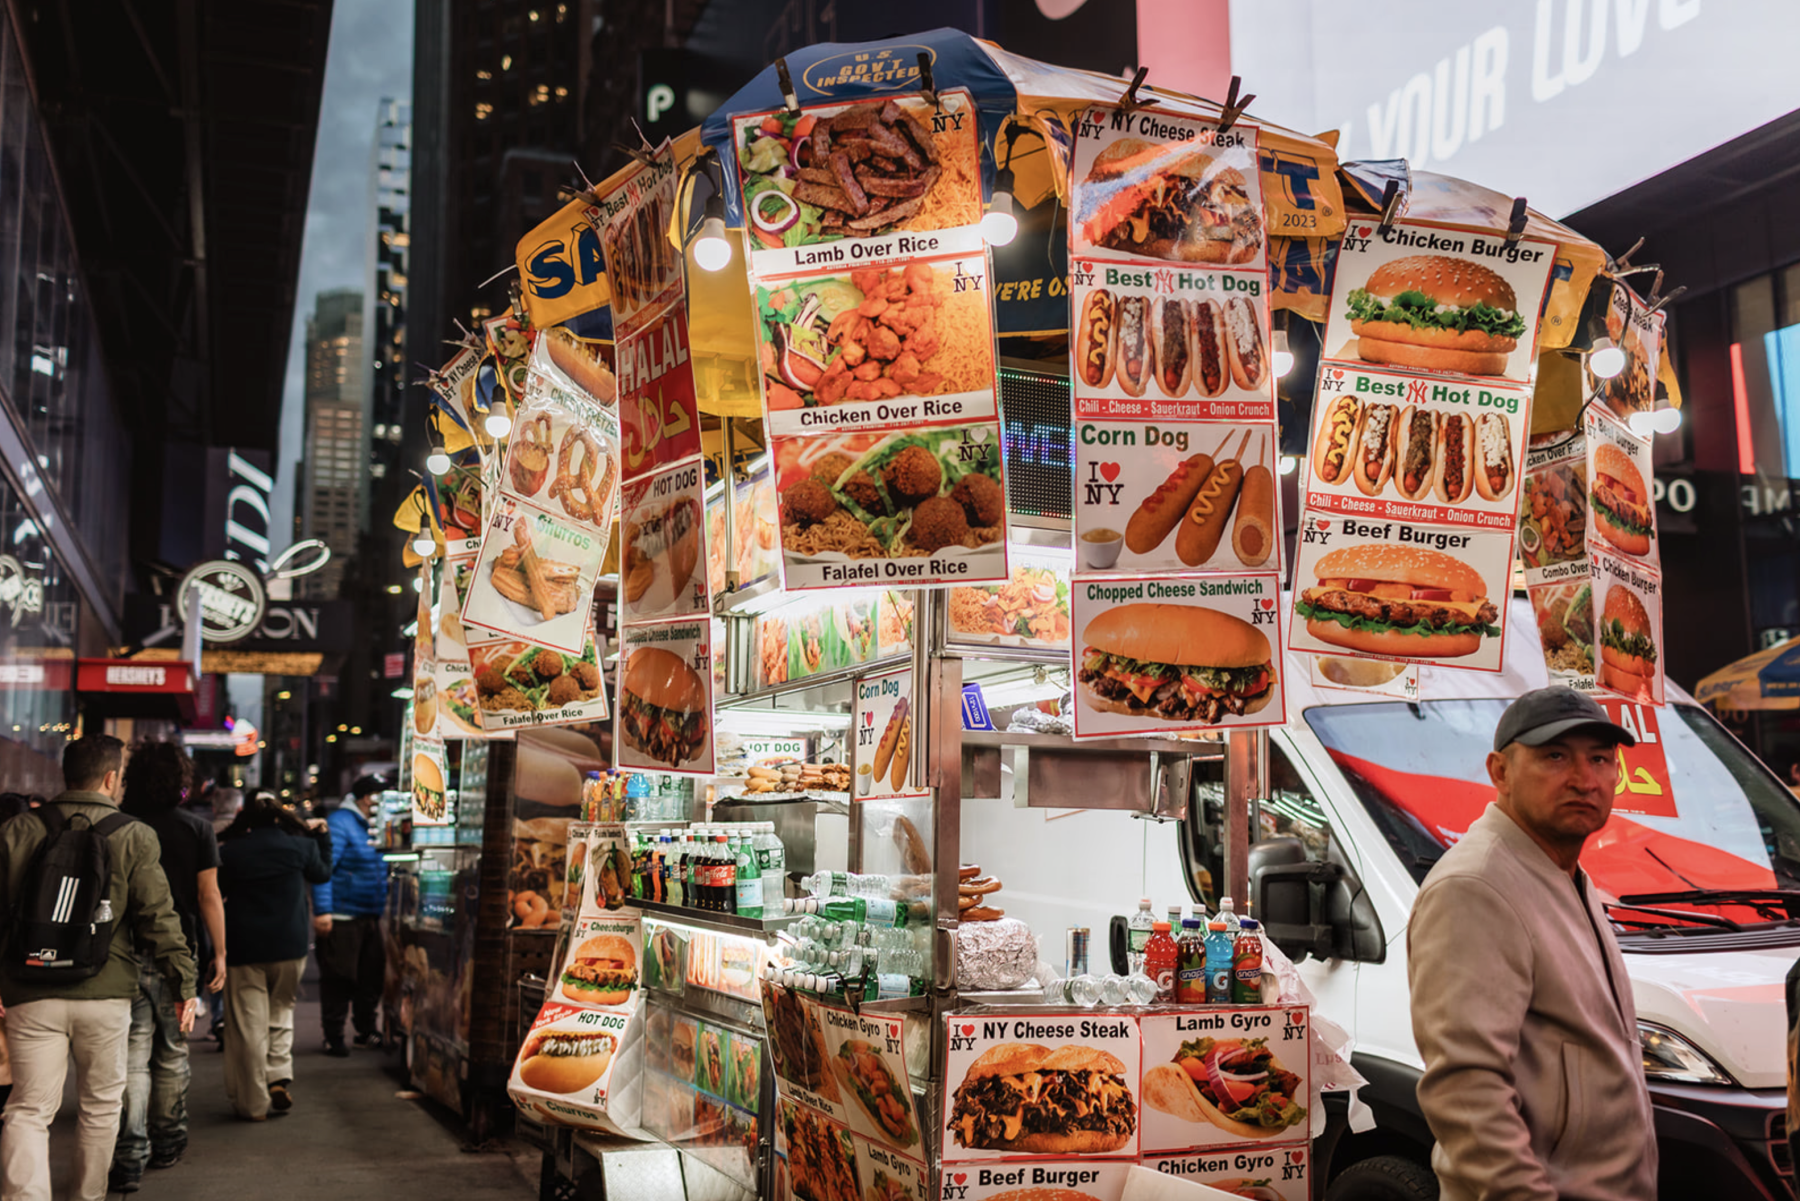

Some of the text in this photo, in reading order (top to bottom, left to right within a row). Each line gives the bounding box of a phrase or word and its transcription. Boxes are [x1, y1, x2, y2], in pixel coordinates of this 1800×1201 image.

[816, 65, 921, 88] INSPECTED
[839, 58, 904, 77] GOV'T
[932, 113, 966, 134] NY
[1083, 109, 1093, 123] I
[1079, 123, 1105, 140] NY
[1110, 114, 1137, 132] NY
[1139, 116, 1196, 142] Cheese
[605, 159, 674, 217] Best Hot Dog
[1283, 214, 1317, 228] 2023
[1349, 224, 1359, 237] I
[795, 236, 939, 265] Lamb Over Rice
[1342, 236, 1372, 253] NY
[1382, 228, 1545, 264] Chicken Burger
[1076, 262, 1083, 274] I
[953, 274, 984, 293] NY
[1074, 273, 1096, 287] NY
[1106, 269, 1153, 288] Best
[1179, 273, 1216, 291] Hot
[1222, 275, 1261, 297] Dog
[621, 315, 688, 397] HALAL
[458, 355, 478, 378] Cheese
[1326, 368, 1332, 380] I
[1322, 379, 1345, 392] NY
[1355, 376, 1405, 398] Best
[1432, 384, 1470, 405] Hot
[1478, 391, 1519, 414] Dog
[800, 406, 871, 427] Chicken
[876, 403, 919, 421] Over
[923, 399, 963, 416] Rice
[1079, 400, 1099, 413] Chili
[1109, 401, 1142, 415] Cheese
[1151, 402, 1201, 416] Sauerkraut
[1210, 403, 1236, 416] Onion
[1238, 403, 1270, 416] Crunch
[628, 382, 691, 469] حلال
[1081, 424, 1190, 452] Corn Dog
[958, 443, 992, 463] NY
[1088, 461, 1099, 483] I
[654, 474, 673, 498] HOT
[675, 468, 698, 491] DOG
[1084, 483, 1125, 505] NY
[1309, 494, 1331, 508] Chili
[1341, 496, 1376, 513] Cheese
[1384, 501, 1438, 520] Sauerkraut
[1447, 508, 1474, 523] Onion
[1477, 511, 1511, 528] Crunch
[492, 514, 514, 532] NY
[536, 514, 591, 551] Churros
[1307, 517, 1316, 530] I
[1303, 529, 1332, 545] NY
[1342, 519, 1471, 550] Beef Burger
[823, 558, 968, 581] Falafel Over Rice
[1542, 562, 1589, 579] Combo Over
[1603, 557, 1657, 594] Chicken Burger
[1087, 579, 1263, 603] Chopped Cheese Sandwich
[1253, 598, 1260, 612] I
[1251, 611, 1277, 625] NY
[670, 623, 701, 641] Sandwich
[106, 666, 166, 685] HERSHEY'S
[1568, 679, 1595, 690] Falafel
[858, 678, 899, 700] Corn Dog
[503, 707, 584, 726] Falafel Over Rice
[859, 727, 875, 746] NY
[774, 742, 801, 753] DOG
[591, 921, 635, 935] Cheeseburger
[1213, 971, 1229, 990] G
[577, 1012, 626, 1030] HOT DOG
[826, 1010, 859, 1031] Chicken
[859, 1017, 880, 1037] Gyro
[1176, 1013, 1272, 1032] Lamb Gyro
[1285, 1012, 1292, 1027] I
[953, 1024, 961, 1038] I
[983, 1020, 1130, 1039] NY Cheese Steak
[1282, 1025, 1306, 1041] NY
[885, 1038, 901, 1055] NY
[950, 1037, 977, 1051] NY
[545, 1100, 599, 1121] Churros
[867, 1143, 911, 1177] Lamb Gyro
[1157, 1154, 1274, 1175] Chicken Gyro
[1284, 1151, 1291, 1166] I
[946, 1173, 953, 1187] I
[978, 1167, 1100, 1188] Beef Burger
[1281, 1164, 1306, 1181] NY
[942, 1185, 970, 1200] NY
